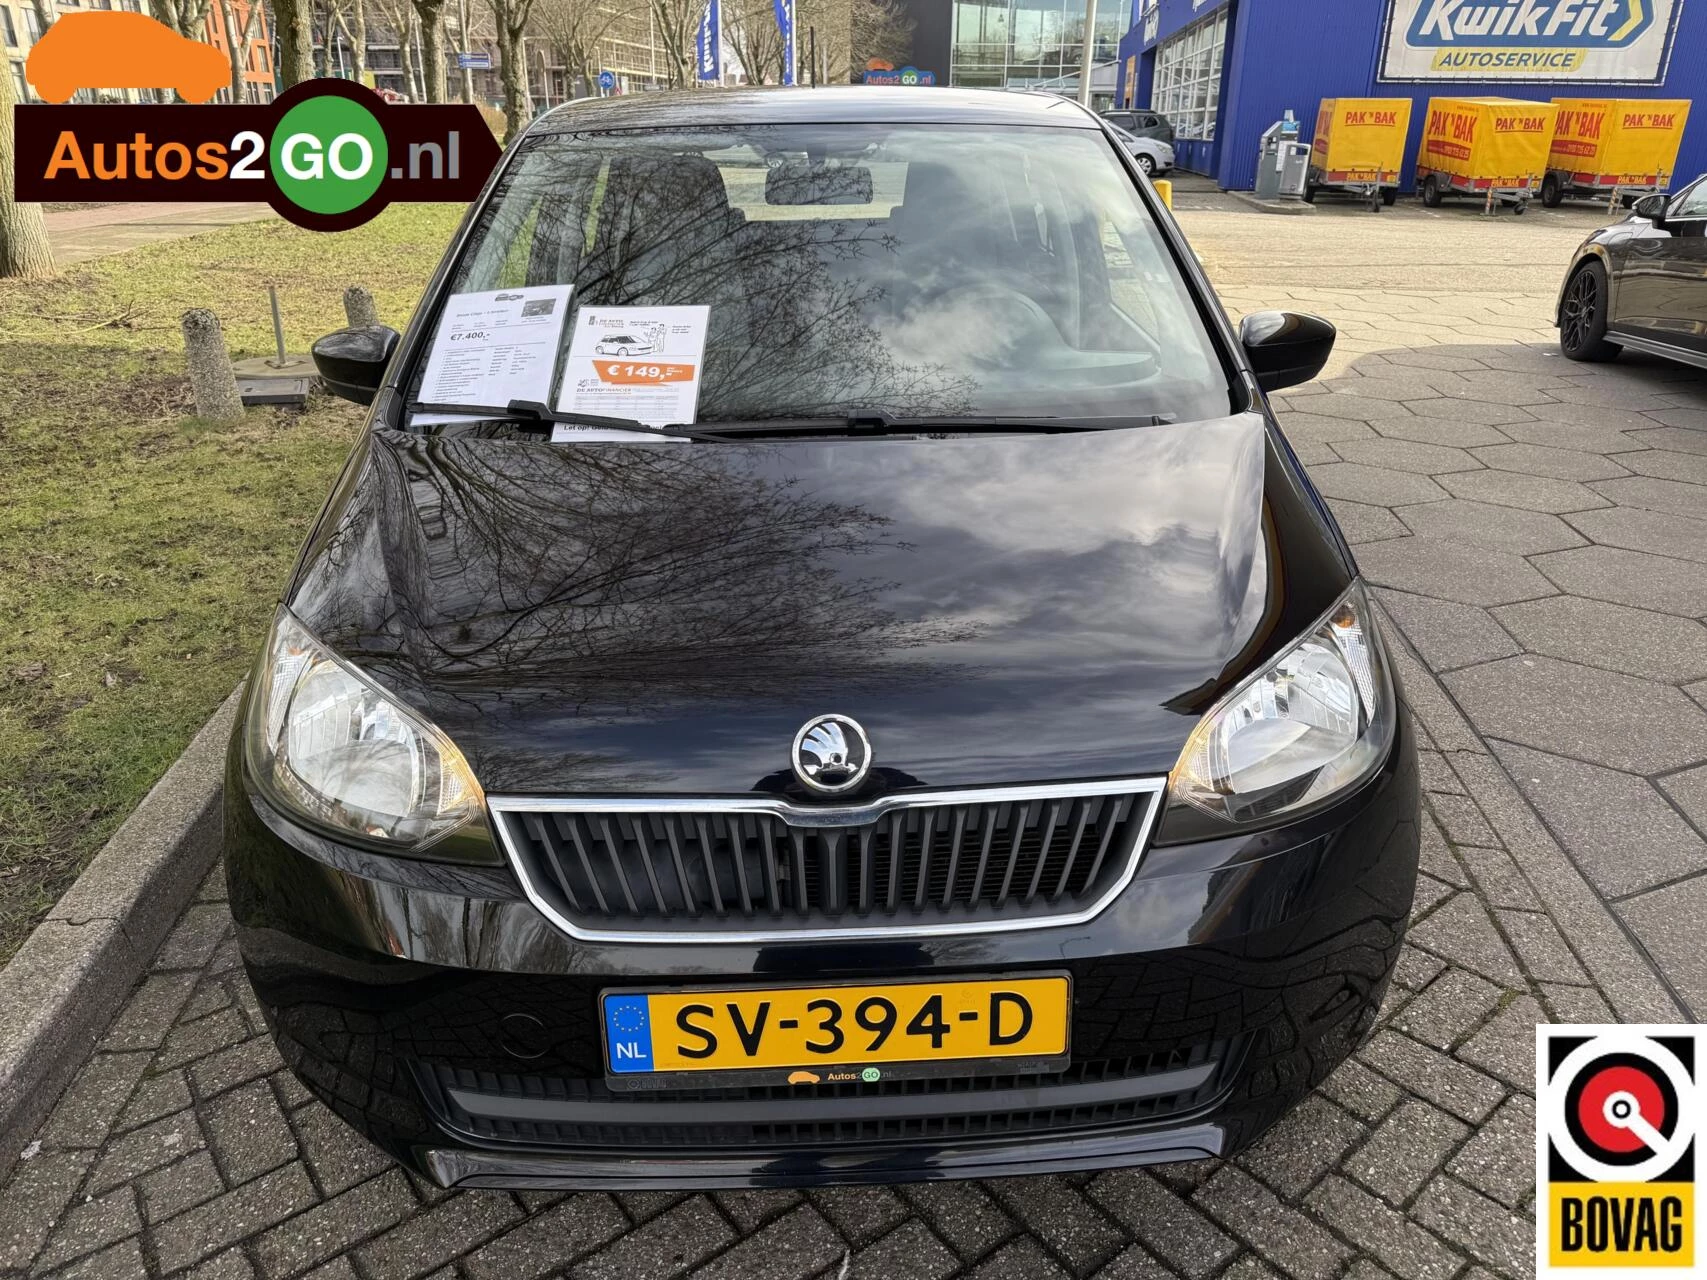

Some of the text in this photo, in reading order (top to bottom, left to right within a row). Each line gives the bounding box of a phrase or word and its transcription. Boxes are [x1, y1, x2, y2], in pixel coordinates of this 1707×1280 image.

[1439, 52, 1577, 67] AUTOSERVICE
[1345, 112, 1367, 124] PAK
[1375, 112, 1397, 124] BAK
[1495, 118, 1516, 130] PAK
[1524, 118, 1546, 130] BAK
[1578, 112, 1605, 139] BAK
[1623, 114, 1645, 126] PAK
[1652, 114, 1676, 126] BAK
[1428, 110, 1450, 136] PAK
[1453, 114, 1477, 143] BAK
[607, 364, 620, 376] €
[676, 991, 1033, 1059] SV-394-D
[616, 1041, 647, 1059] NL
